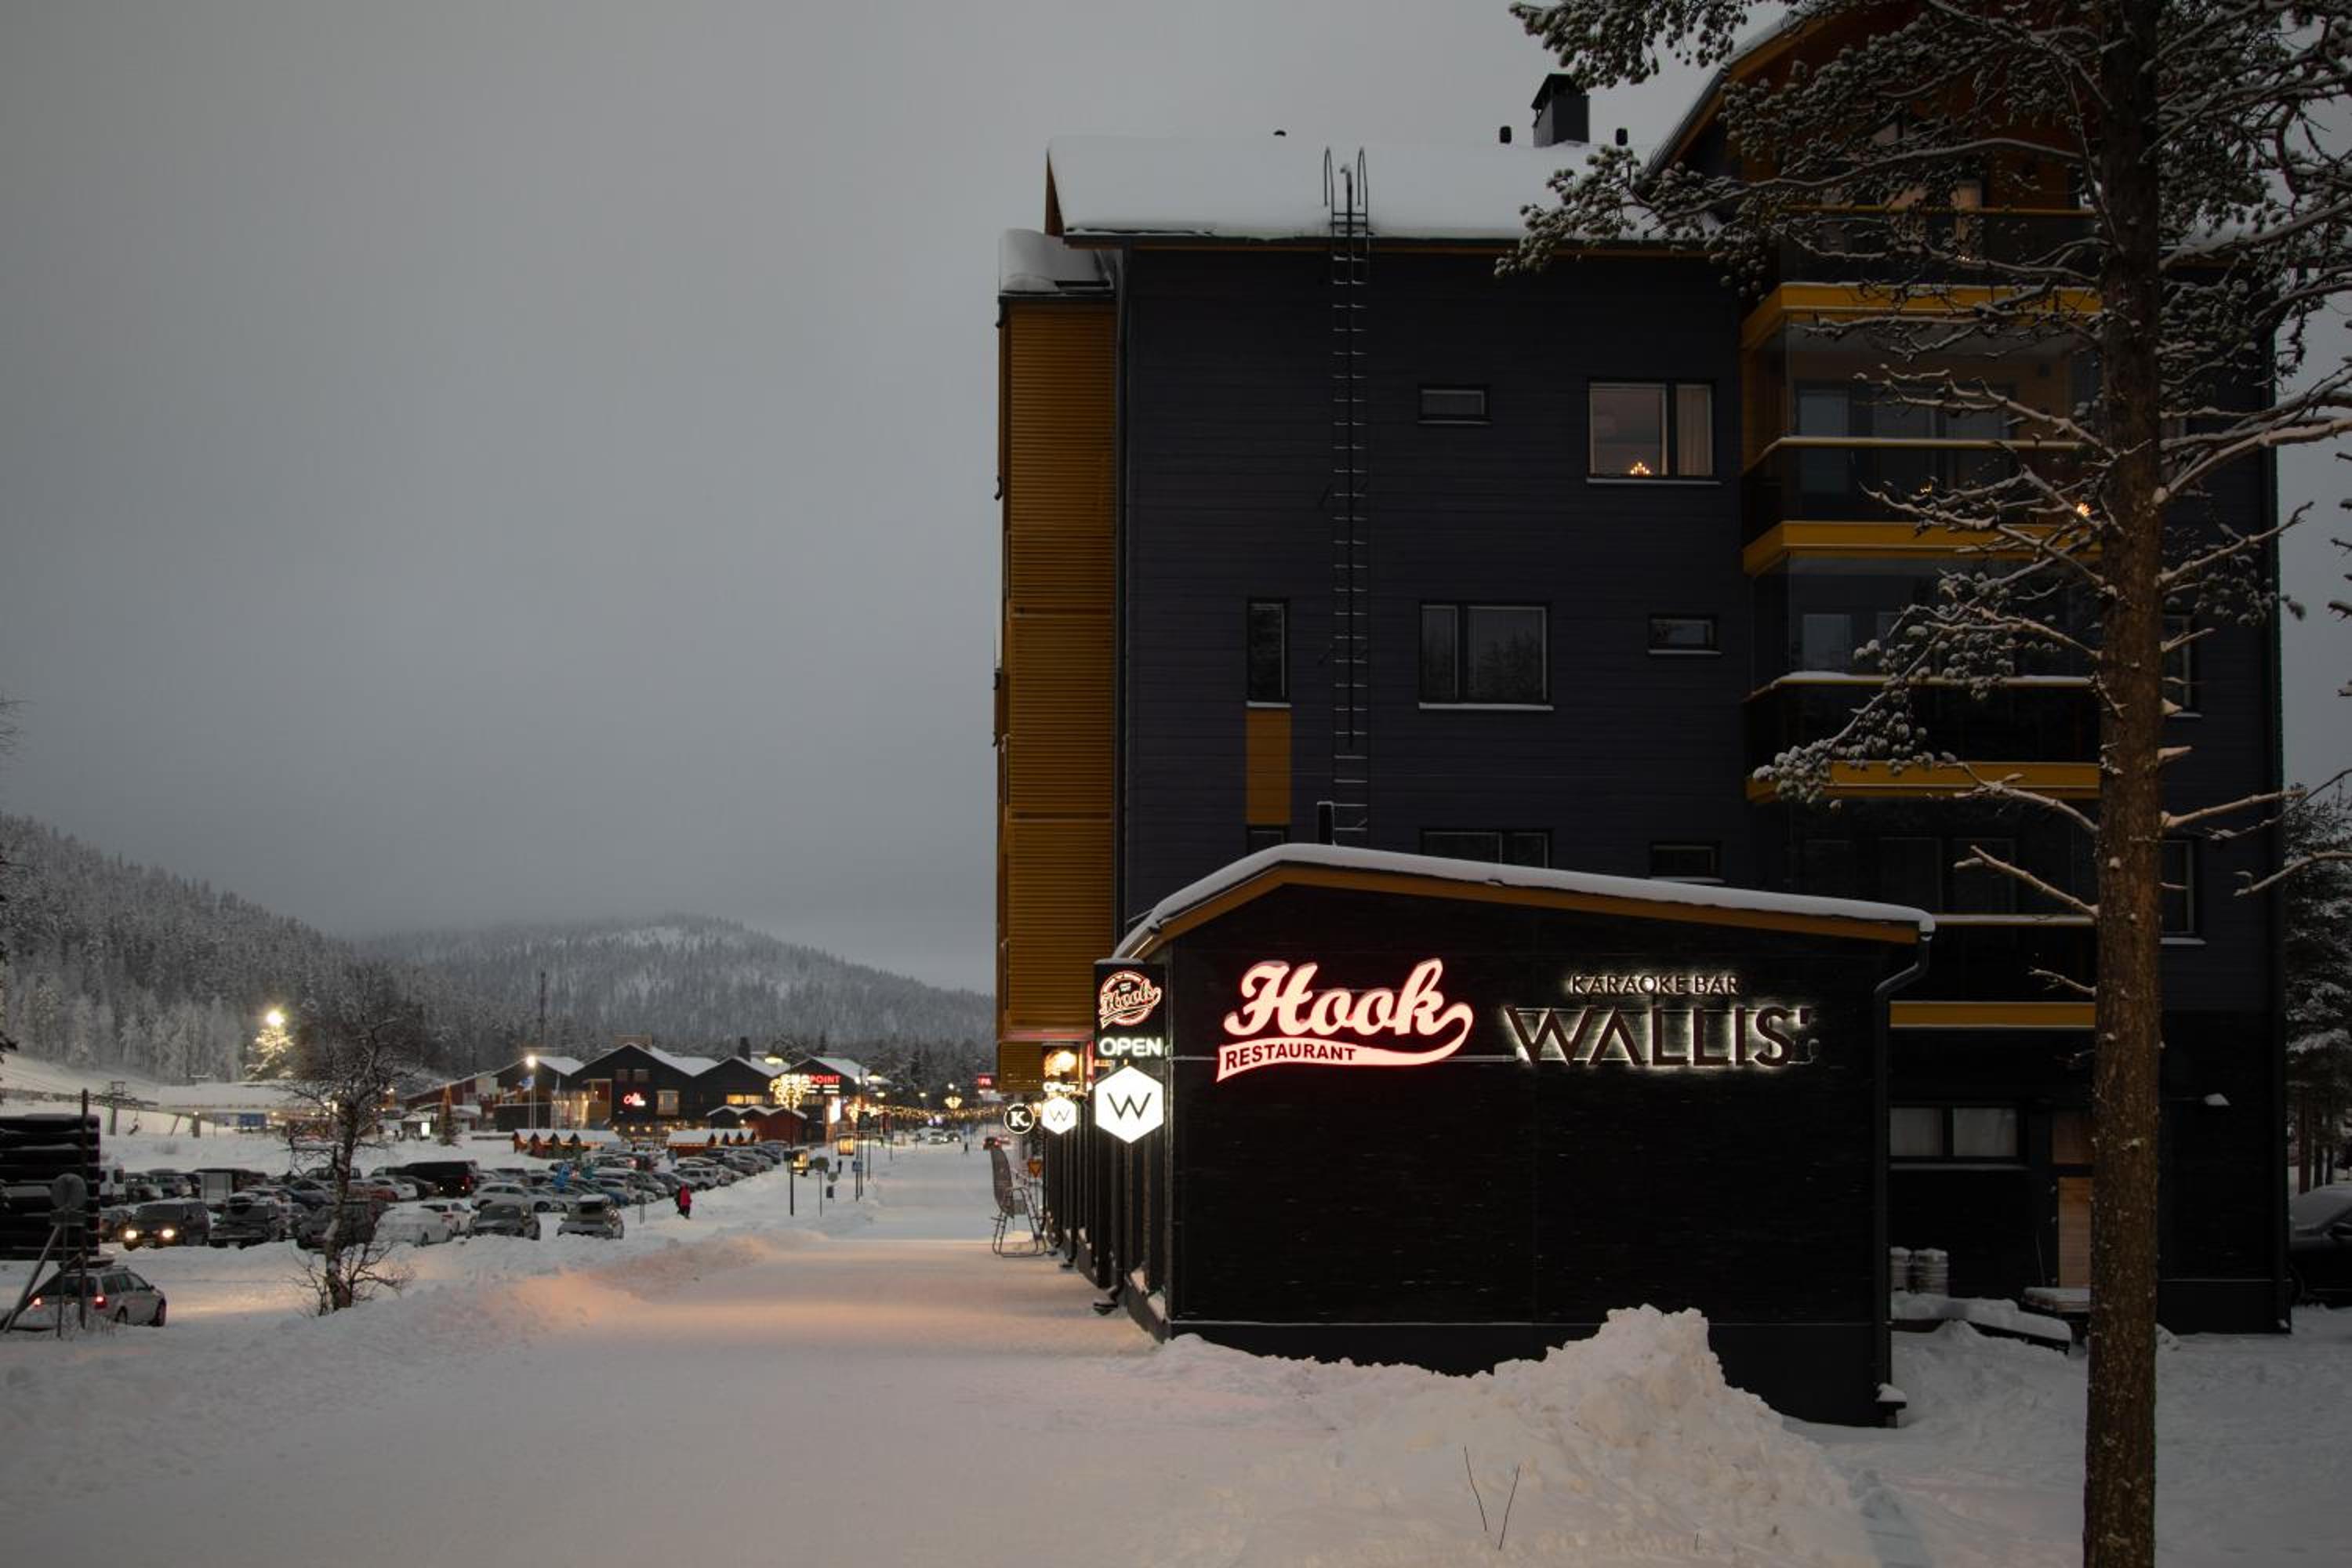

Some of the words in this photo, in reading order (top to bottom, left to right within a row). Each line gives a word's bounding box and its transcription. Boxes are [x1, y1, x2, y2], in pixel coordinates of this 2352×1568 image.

[1570, 975, 1687, 995] KARAOKE
[1693, 975, 1740, 995] BAR
[1223, 958, 1473, 1036] Hook
[1099, 1037, 1162, 1056] OPEN
[1225, 1044, 1356, 1070] RESTAURANT
[1107, 1092, 1152, 1120] W
[1010, 1111, 1030, 1127] K
